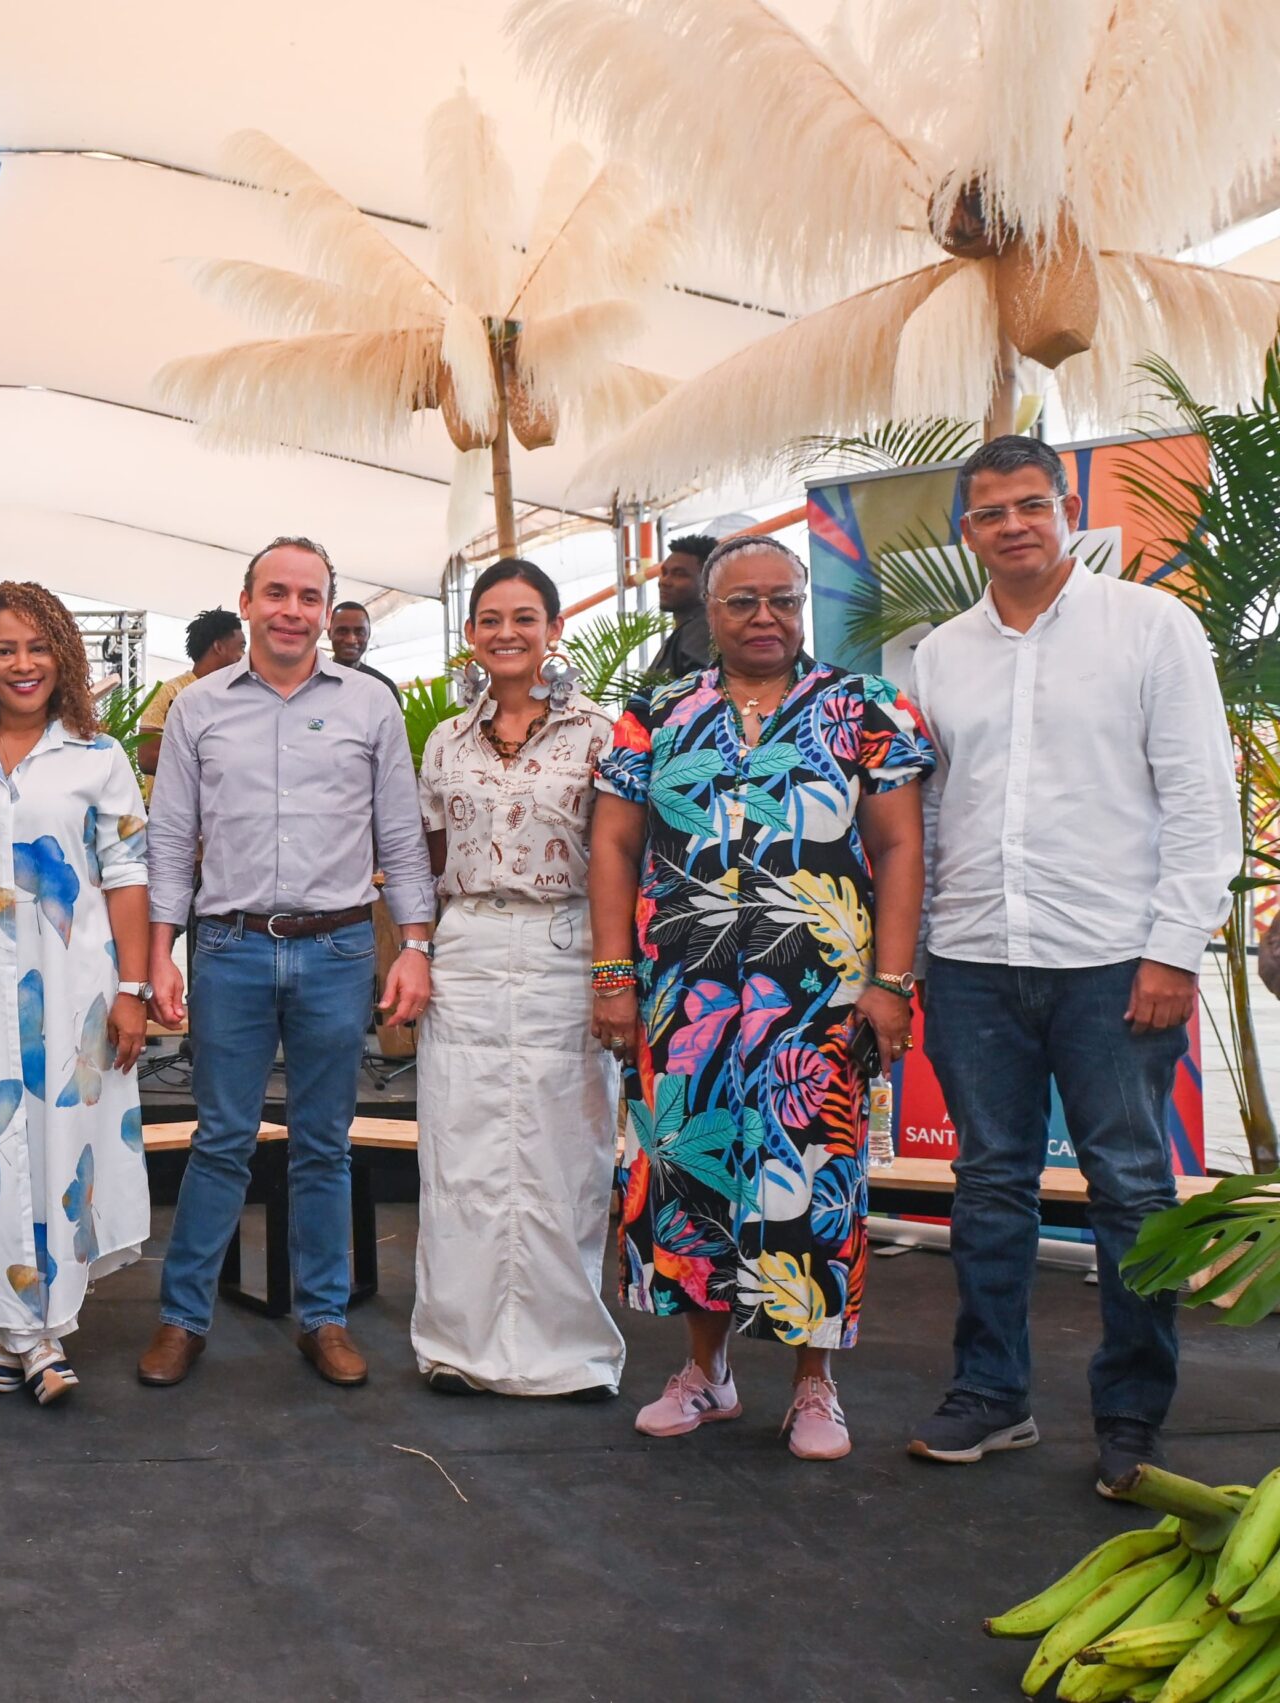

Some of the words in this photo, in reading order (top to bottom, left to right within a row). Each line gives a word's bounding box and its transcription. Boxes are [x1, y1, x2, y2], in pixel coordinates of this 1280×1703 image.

[559, 714, 593, 729] MOR
[534, 872, 571, 889] AMOR
[905, 1126, 956, 1146] SANT
[1047, 1139, 1078, 1157] CA
